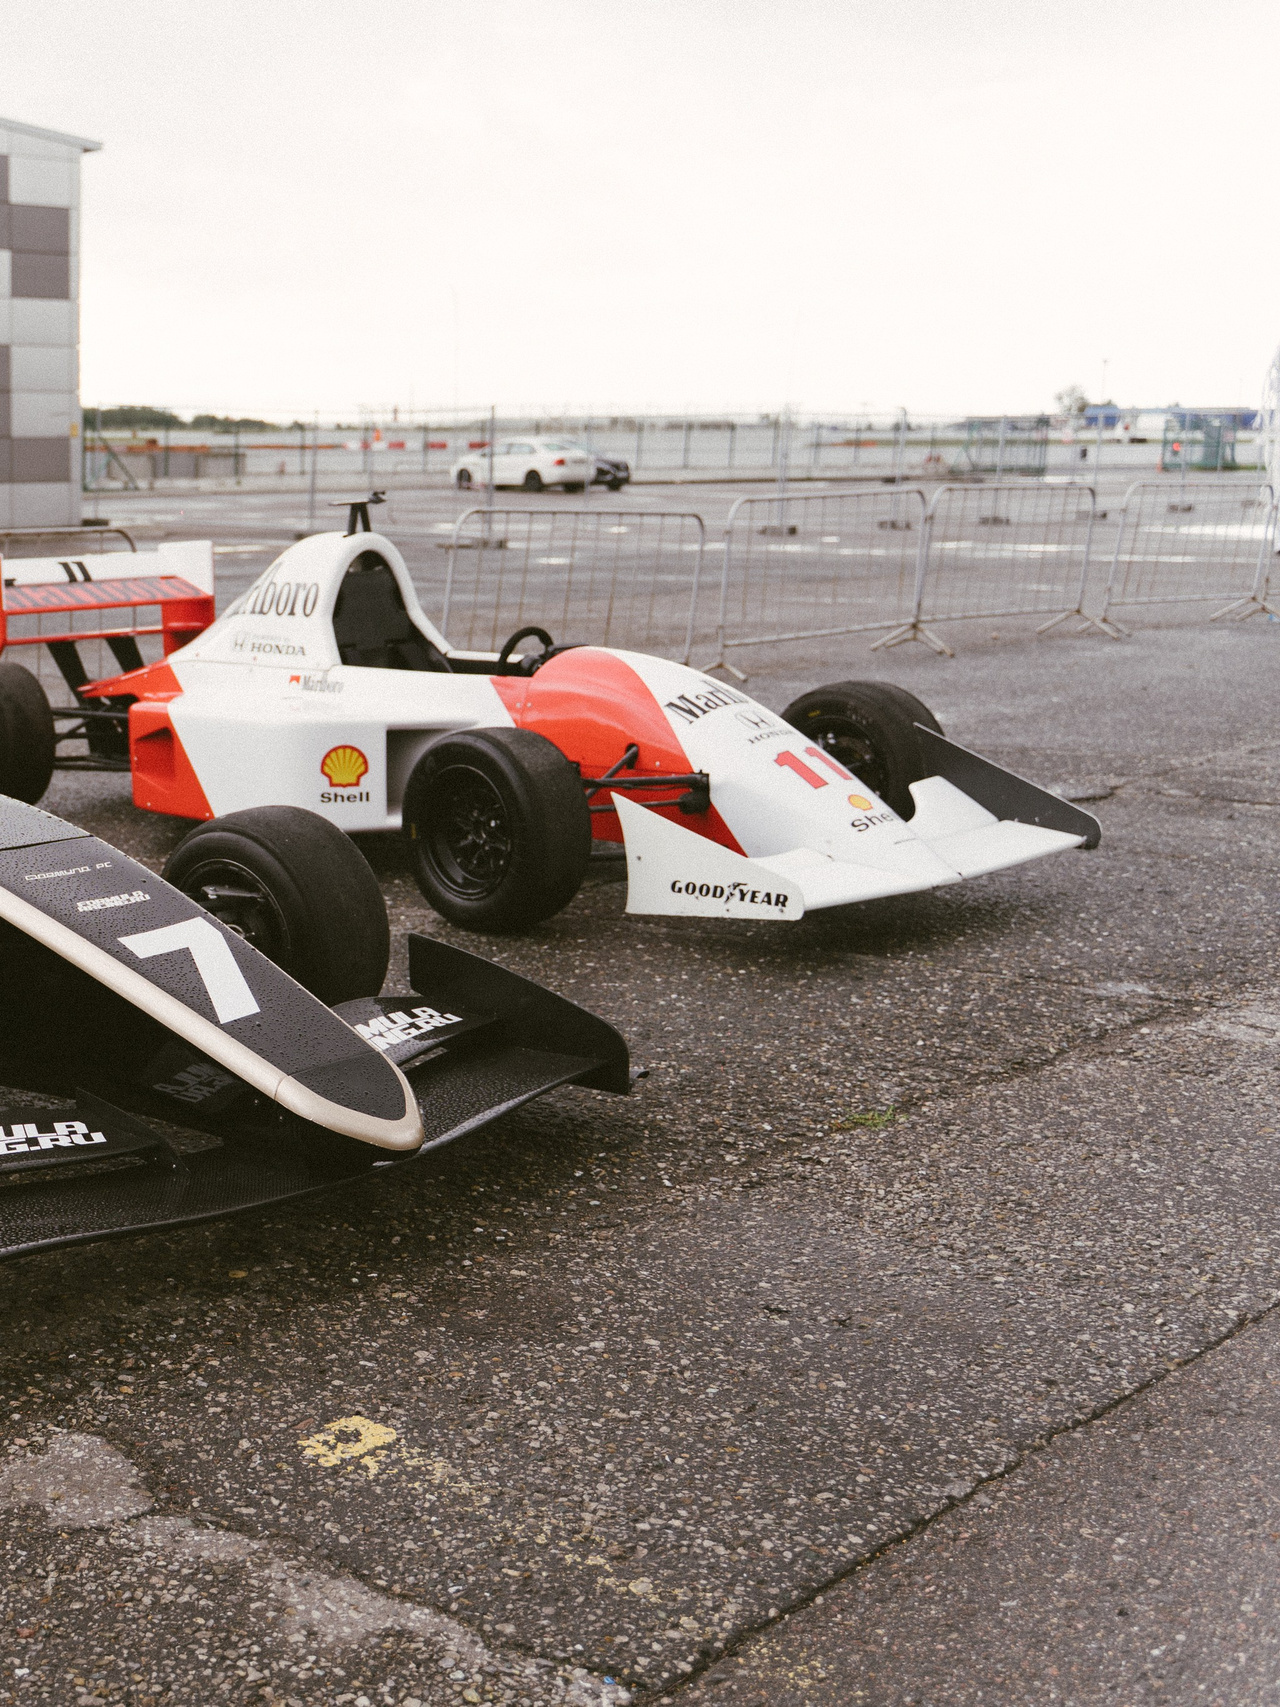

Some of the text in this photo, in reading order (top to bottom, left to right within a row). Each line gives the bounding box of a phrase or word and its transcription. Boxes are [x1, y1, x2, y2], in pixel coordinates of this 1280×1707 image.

[250, 642, 307, 657] HONDA
[774, 746, 854, 789] 11
[320, 791, 370, 804] Shell
[851, 812, 894, 832] She
[117, 916, 261, 1025] 7
[353, 1006, 442, 1040] MULA
